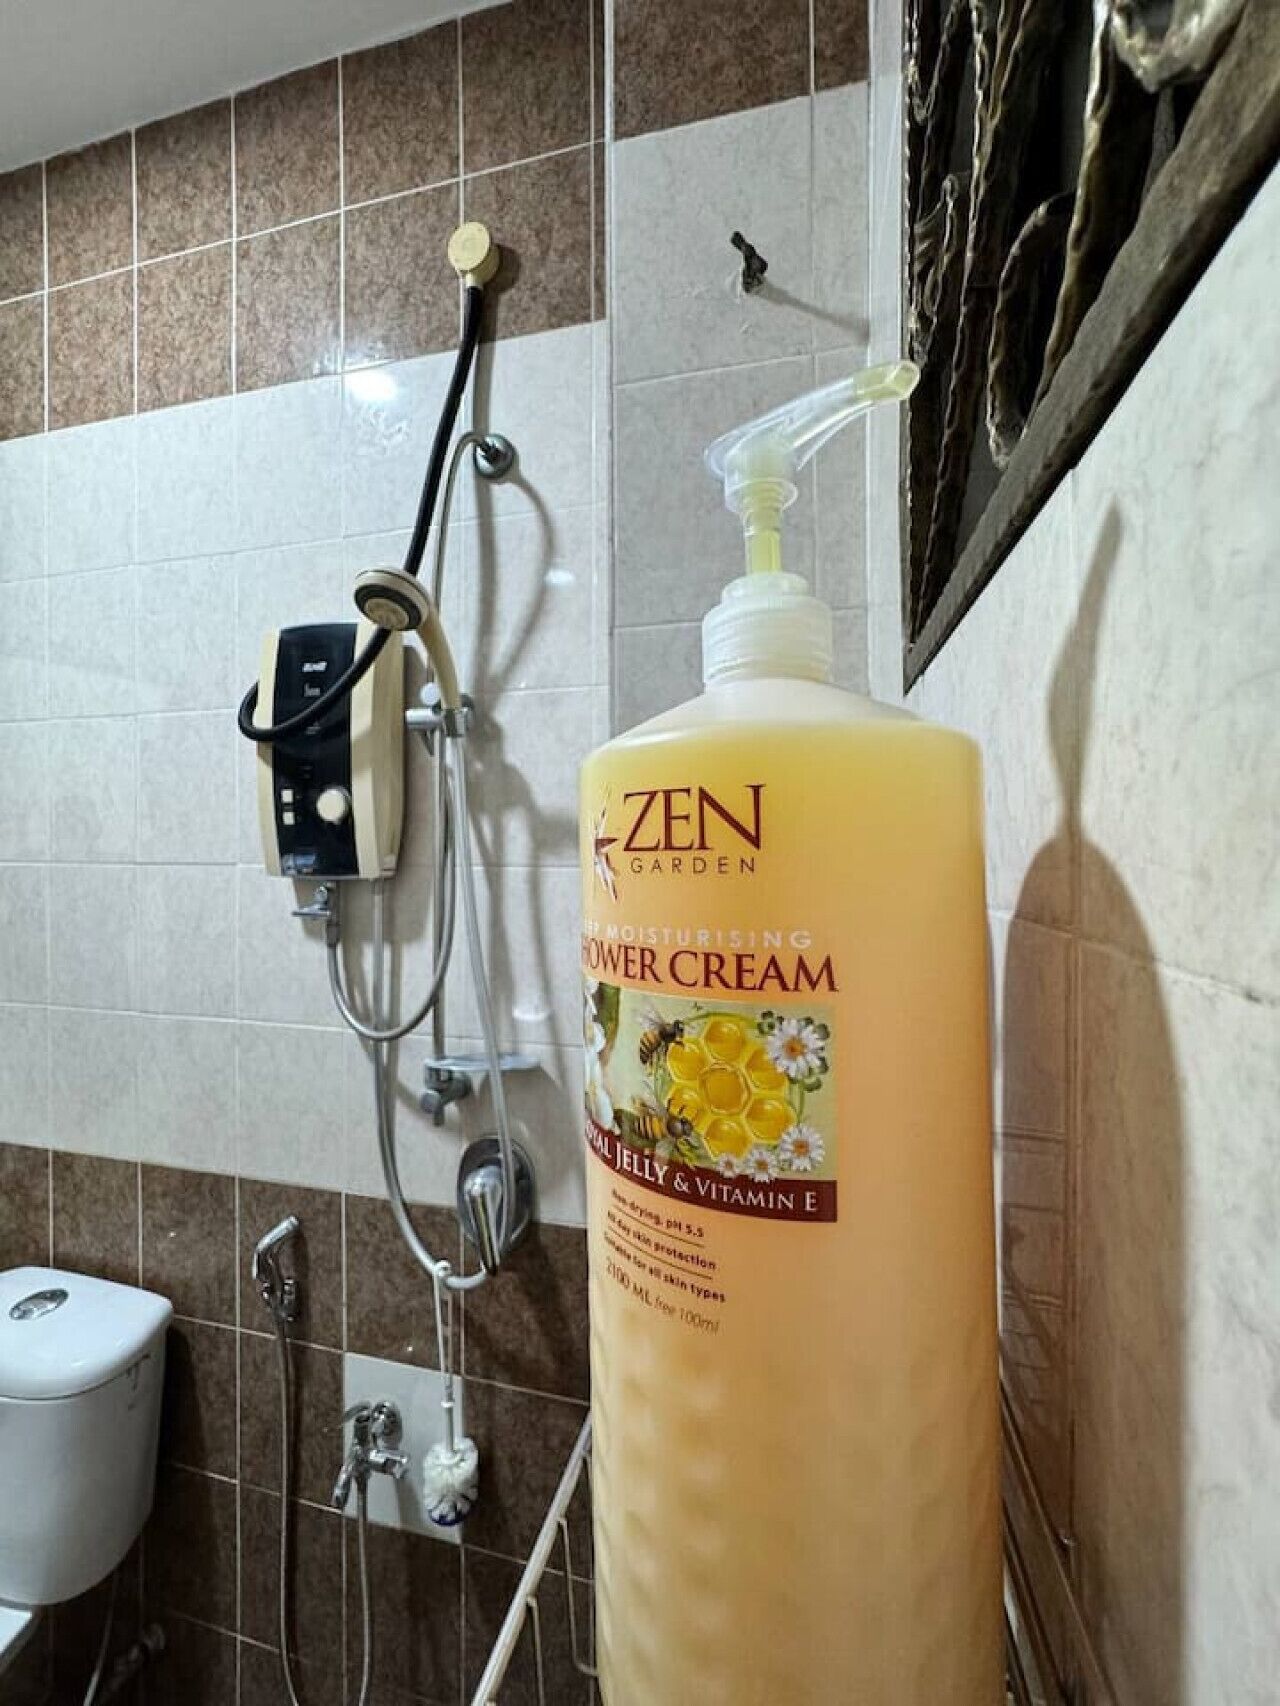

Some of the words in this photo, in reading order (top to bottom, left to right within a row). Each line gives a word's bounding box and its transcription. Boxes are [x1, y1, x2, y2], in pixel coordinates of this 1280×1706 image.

[623, 783, 767, 852] ZEN
[630, 856, 756, 875] GARDEN
[606, 923, 812, 950] MOISTURISING
[582, 937, 664, 984] HOWER
[668, 950, 840, 993] CREAM
[586, 1119, 612, 1159] OYAL
[615, 1142, 670, 1186] JELLY
[673, 1172, 690, 1194] &
[695, 1177, 795, 1211] VITAMIN
[804, 1191, 818, 1213] E
[685, 1224, 705, 1238] 5.5
[653, 1242, 716, 1271] protection
[606, 1256, 630, 1289] 2100
[632, 1281, 652, 1306] ML
[654, 1295, 675, 1316] free
[663, 1273, 687, 1291] skin
[690, 1282, 726, 1304] types
